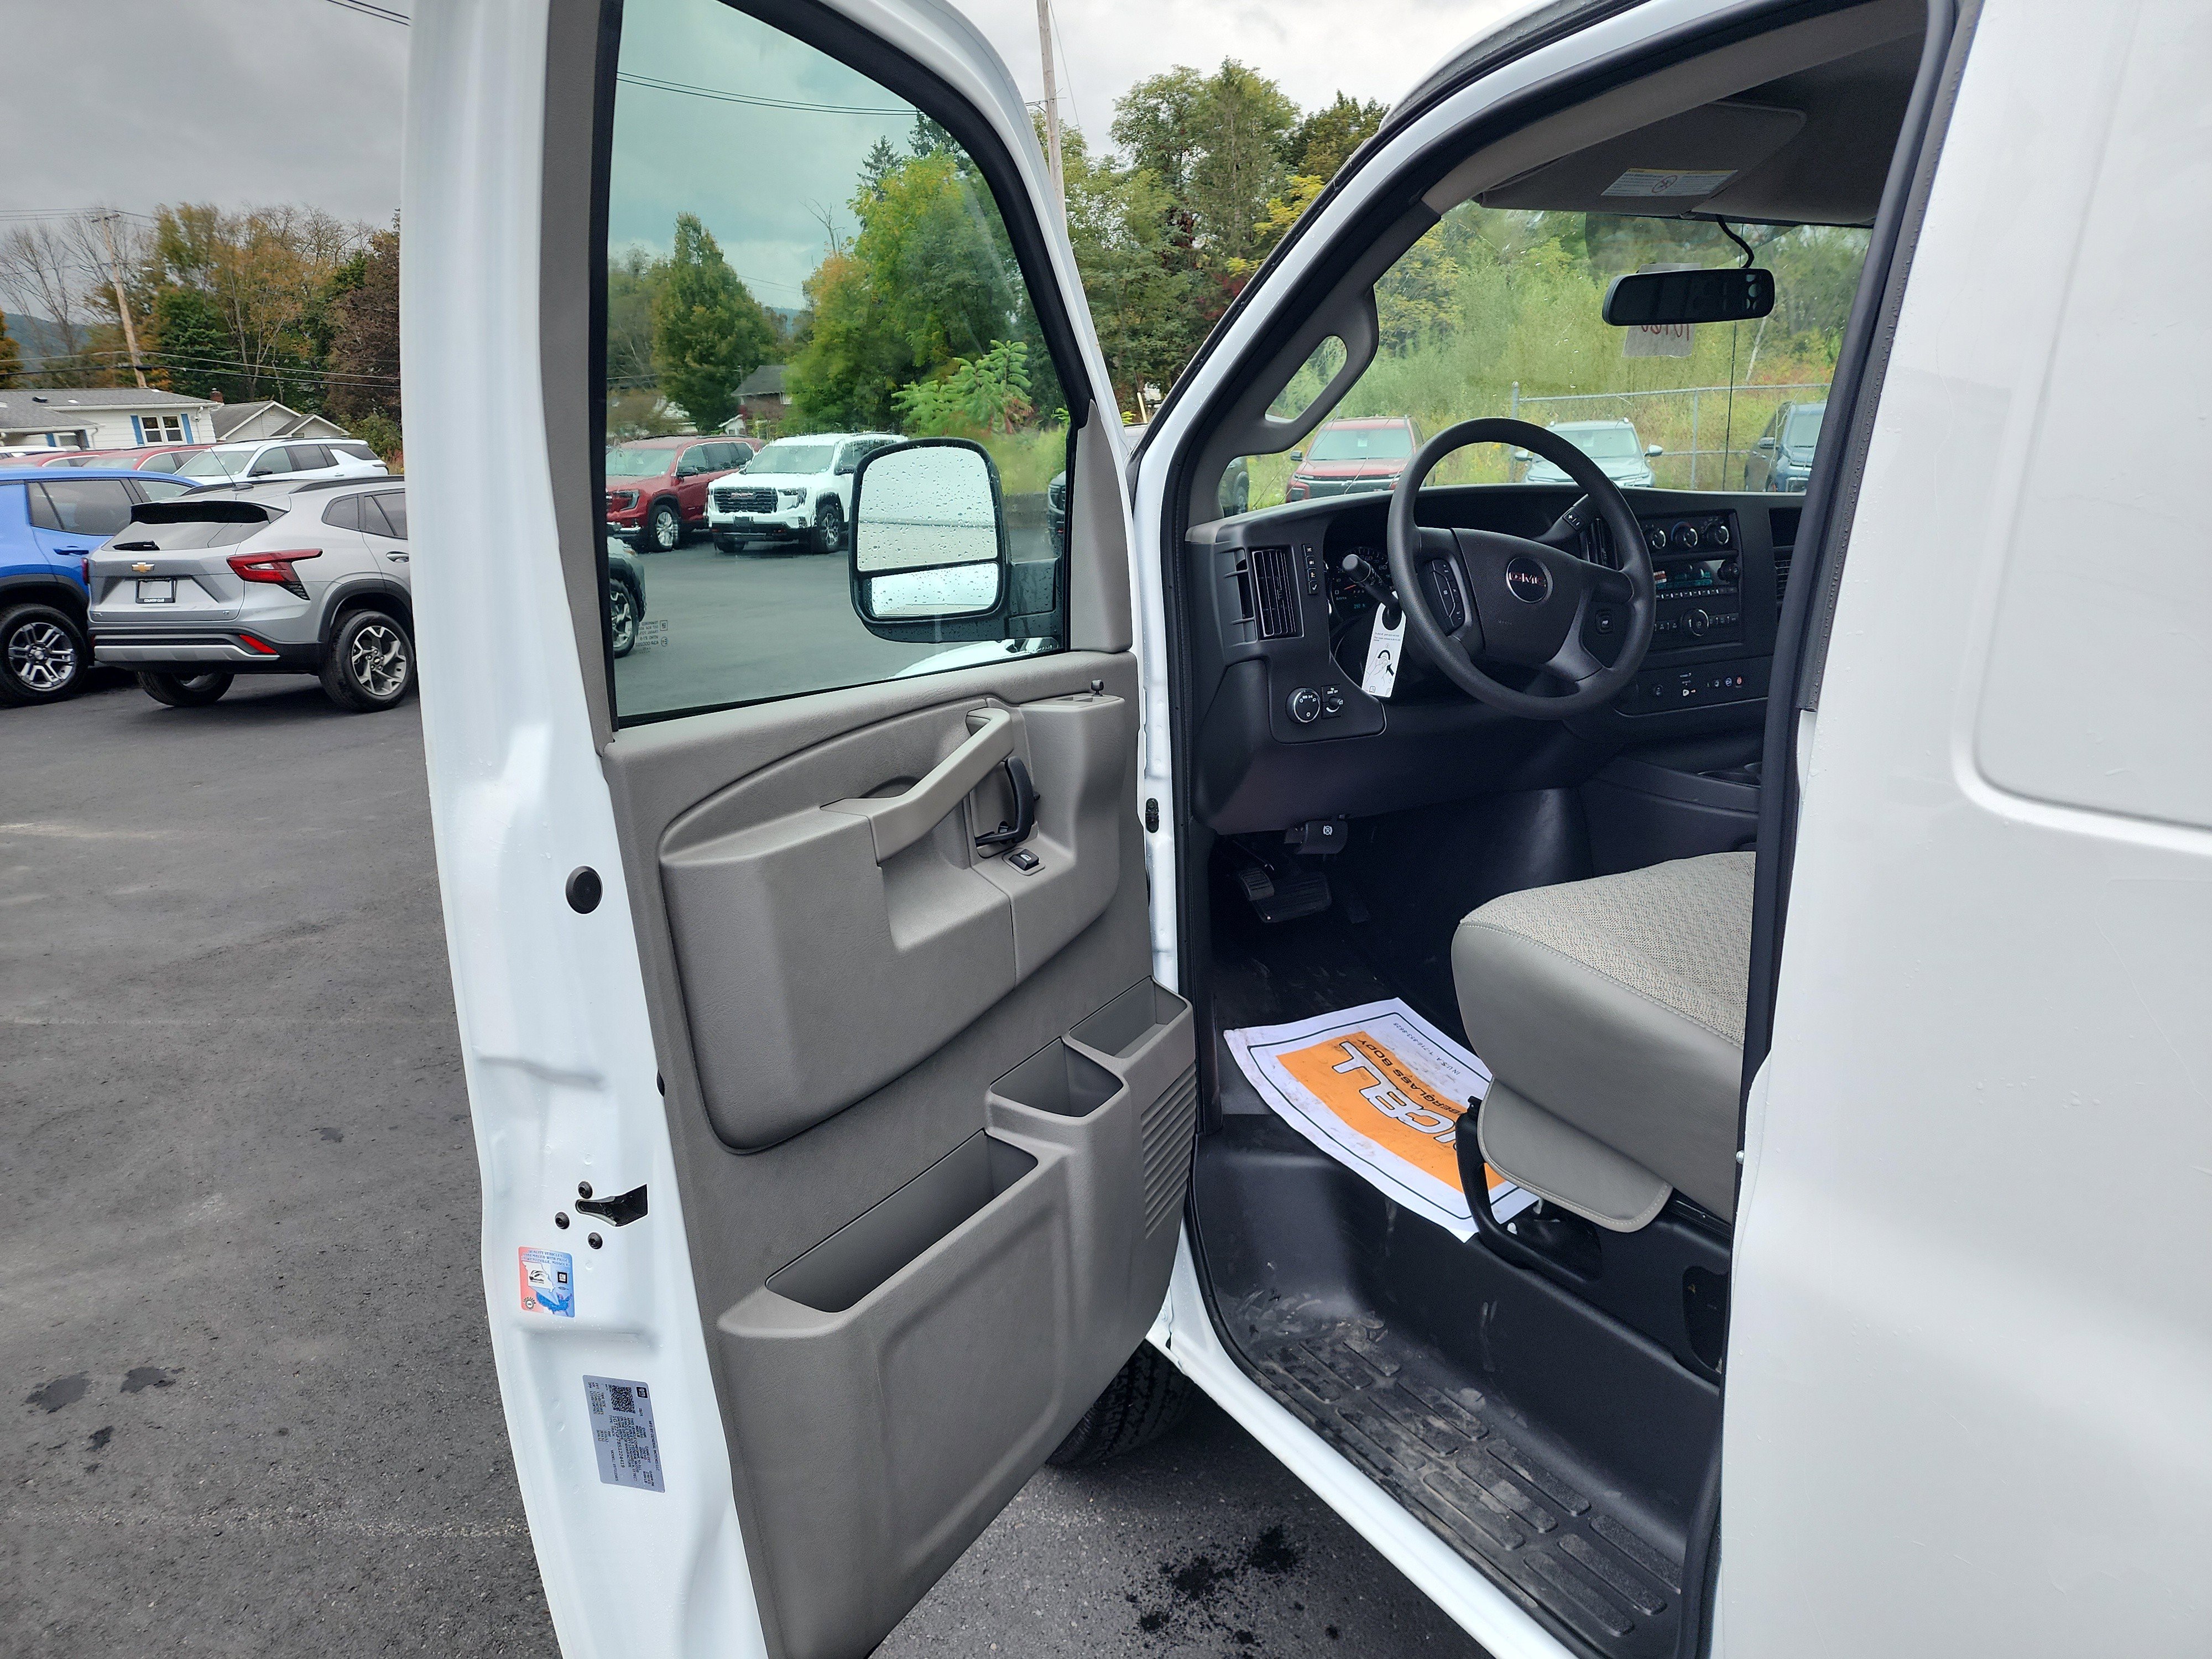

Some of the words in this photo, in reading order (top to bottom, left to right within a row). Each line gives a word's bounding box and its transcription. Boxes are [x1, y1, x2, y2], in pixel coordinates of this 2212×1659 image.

[1509, 572, 1546, 587] GMC
[1358, 1039, 1394, 1067] BODY
[1332, 1041, 1457, 1145] ICELL
[1394, 1068, 1464, 1115] BERGLASS
